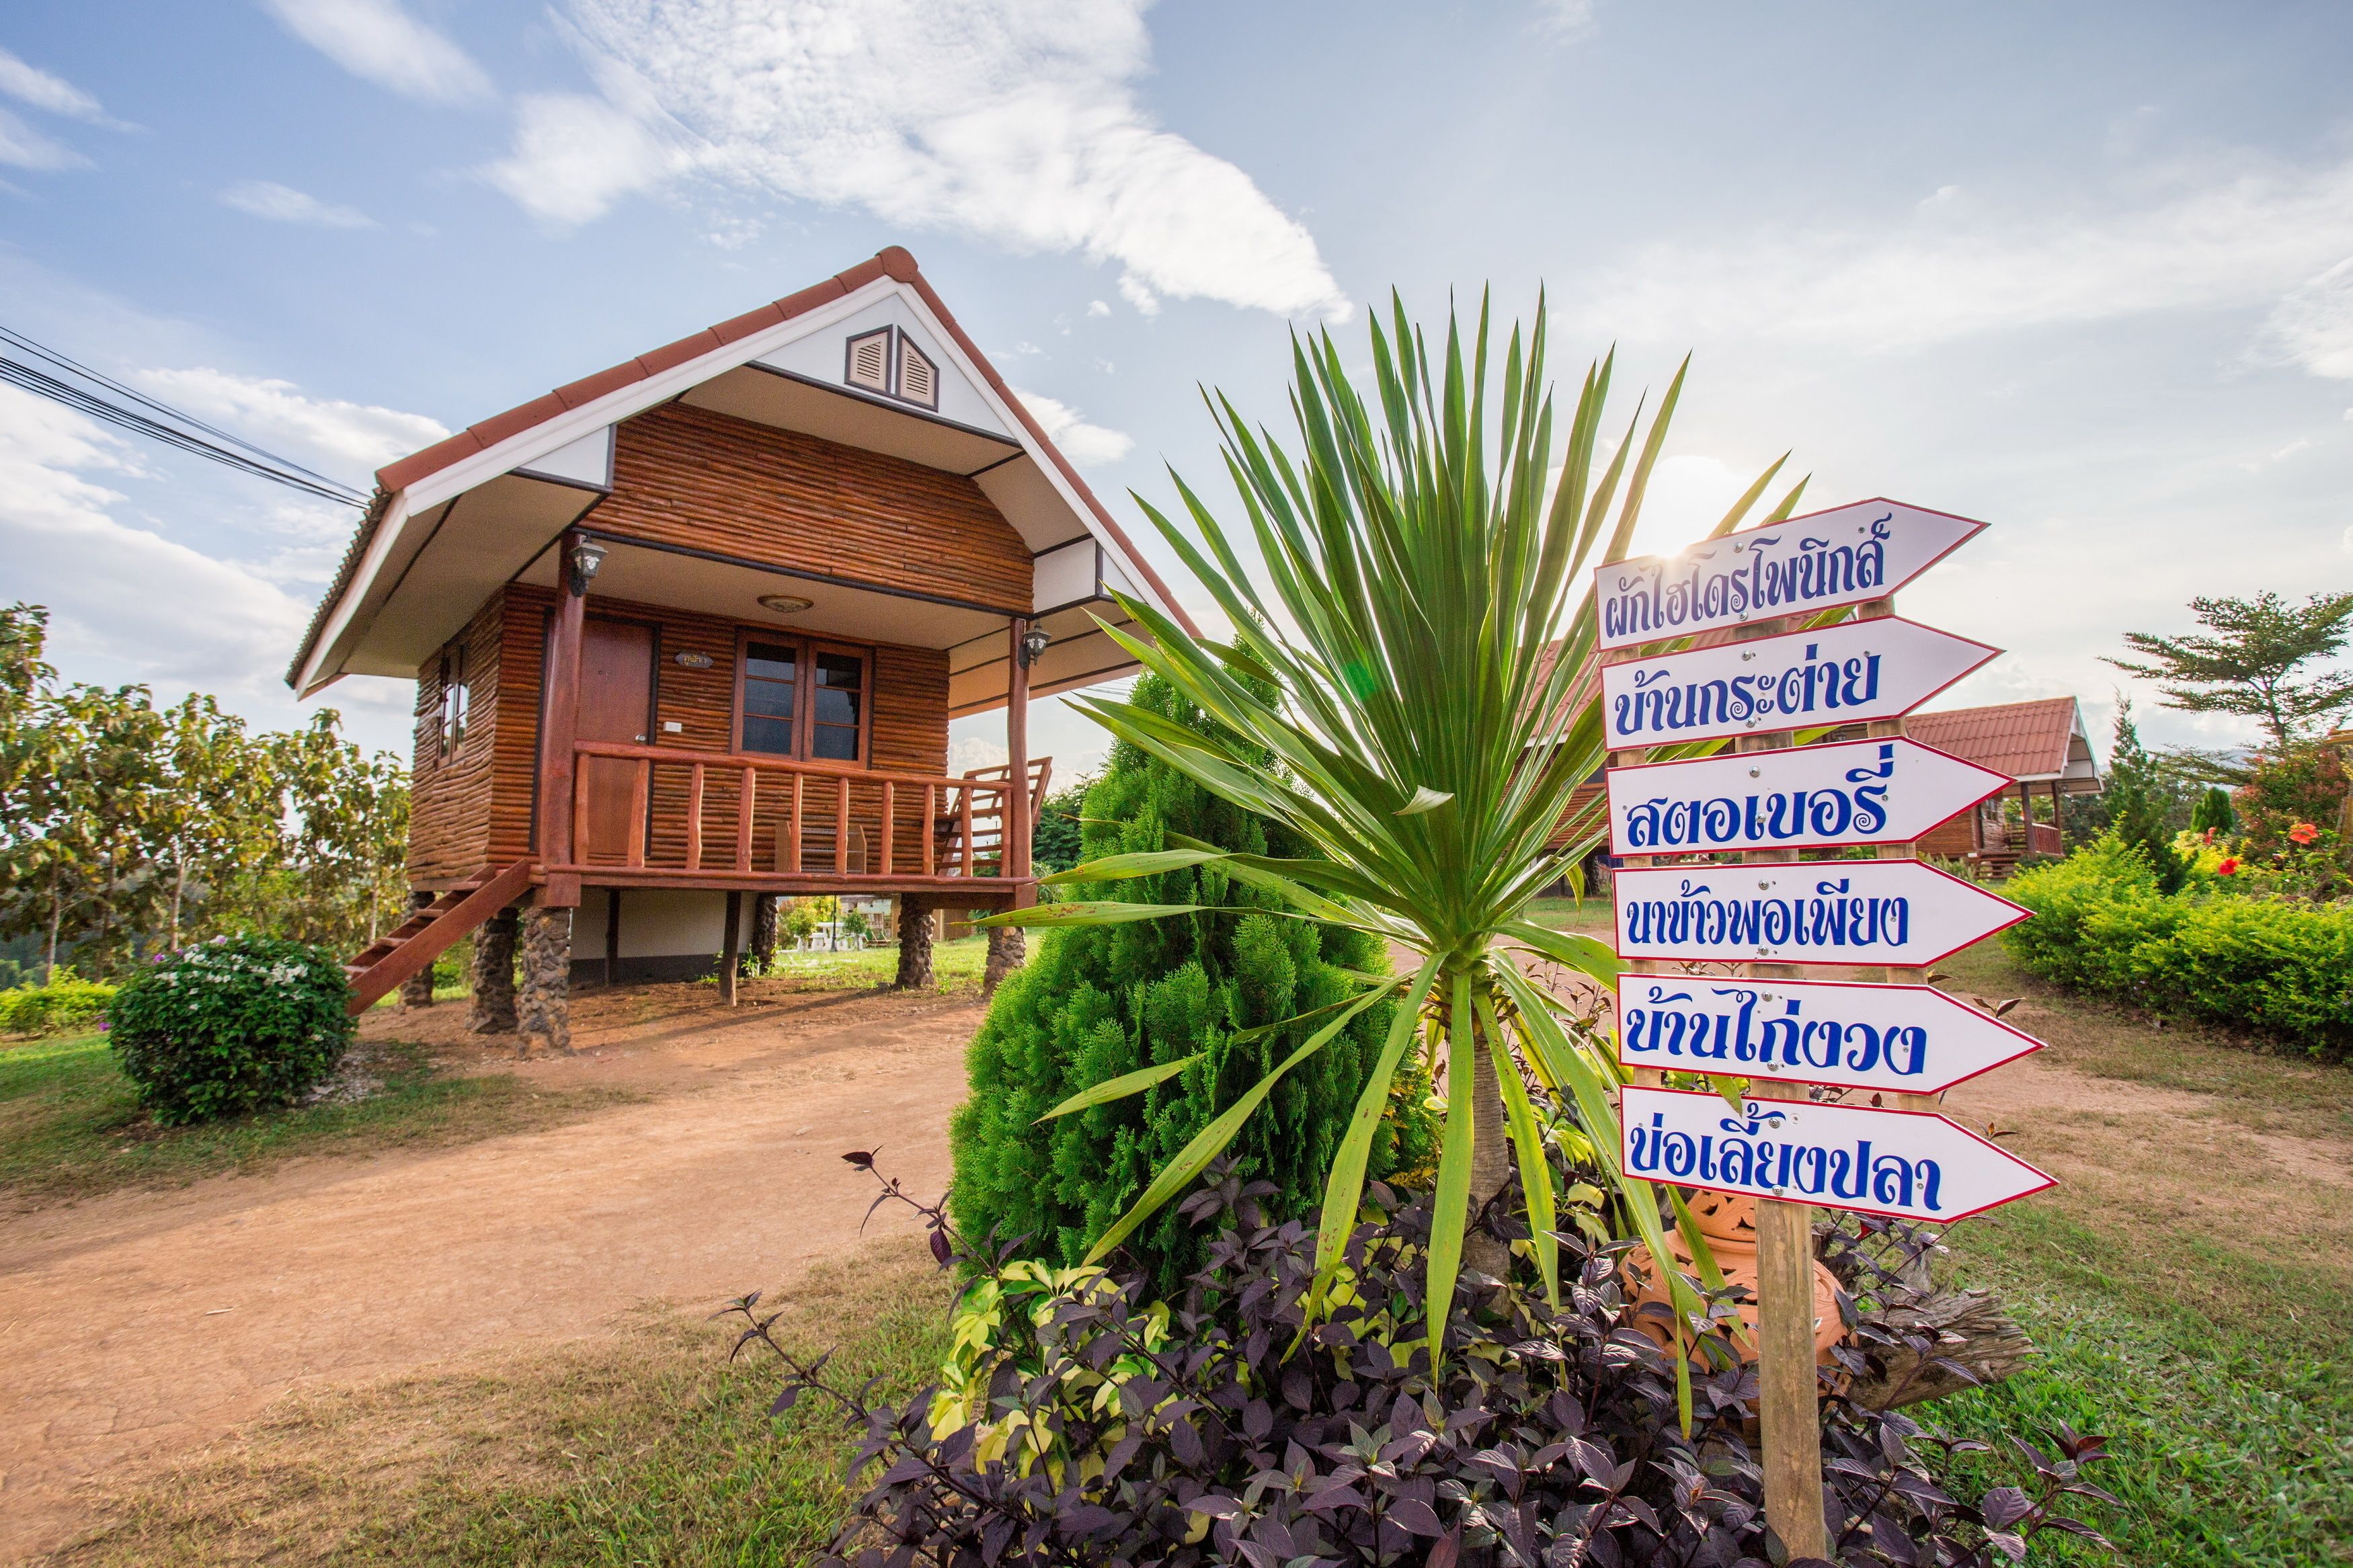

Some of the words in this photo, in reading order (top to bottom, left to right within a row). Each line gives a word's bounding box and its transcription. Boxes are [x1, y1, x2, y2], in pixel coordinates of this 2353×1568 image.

[1605, 512, 1892, 638] ผักไฮโดรโพนิกส์
[1615, 643, 1881, 735] บ้านกระต่าย
[1626, 743, 1894, 848] สตอเบอรี่
[1627, 878, 1909, 947] นาข้าวพอเพียง
[1626, 985, 1927, 1076] บ้านไก่งวง
[1630, 1102, 1942, 1211] บ่อเลี้ยงปลา
